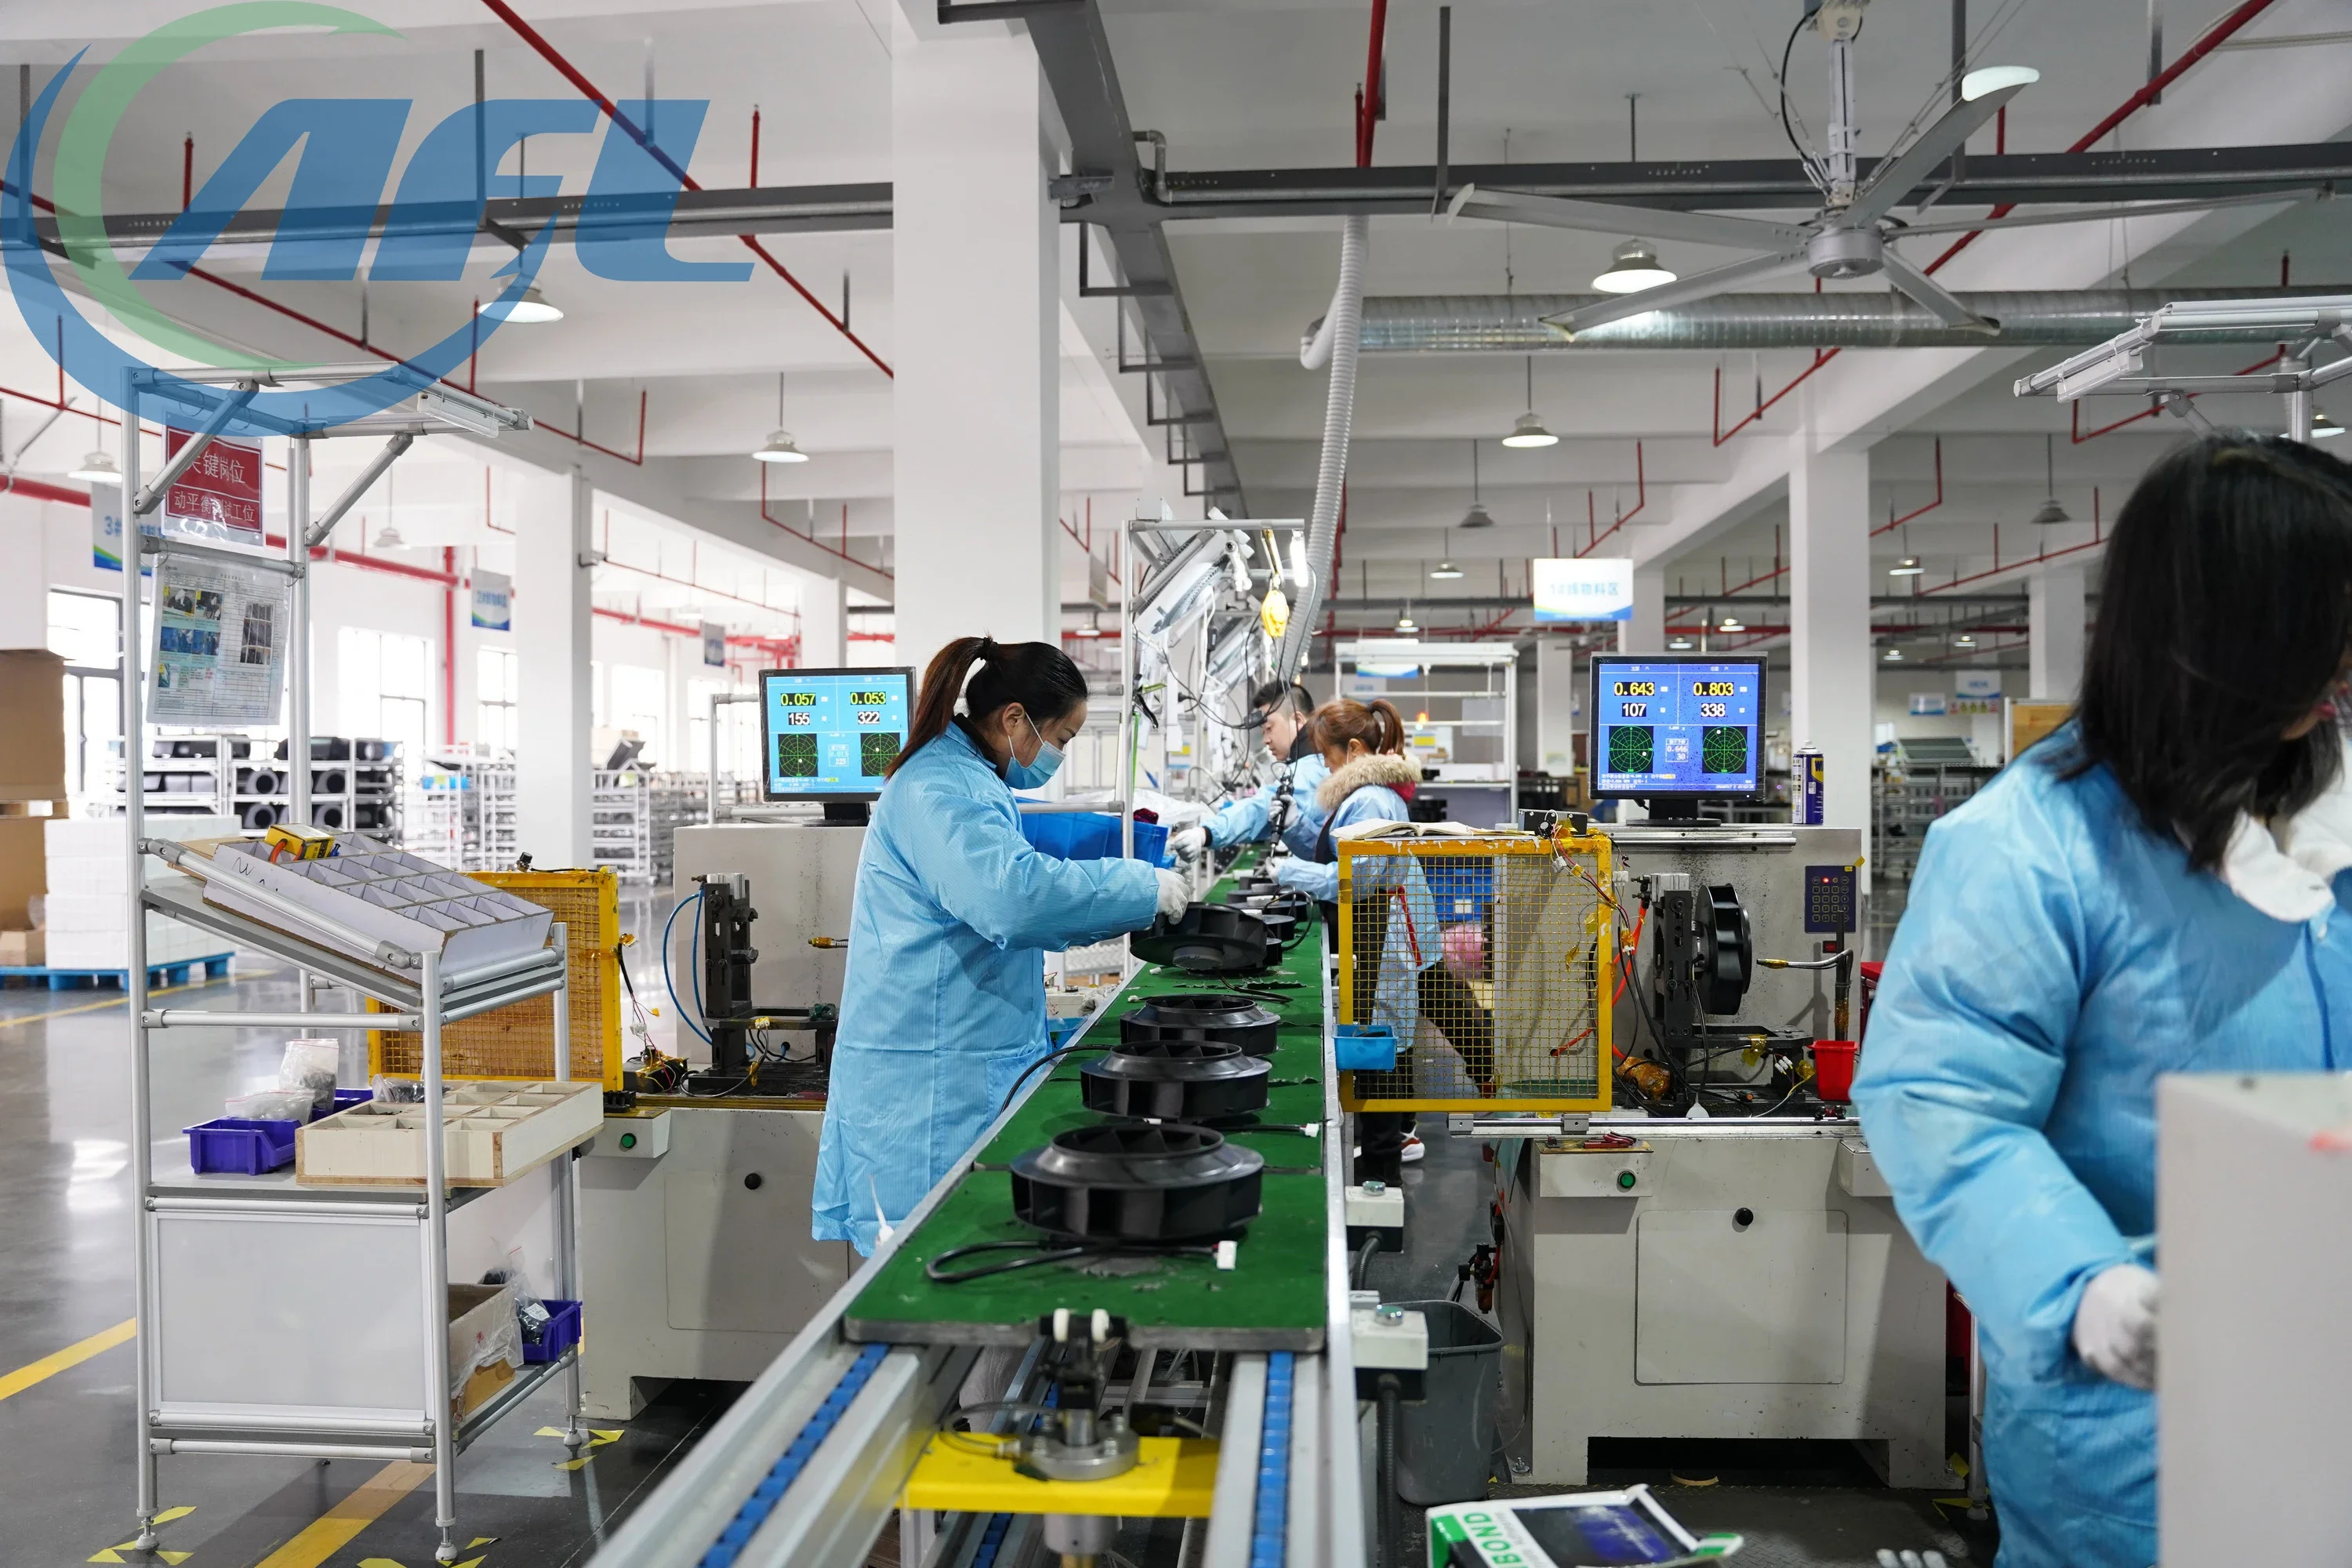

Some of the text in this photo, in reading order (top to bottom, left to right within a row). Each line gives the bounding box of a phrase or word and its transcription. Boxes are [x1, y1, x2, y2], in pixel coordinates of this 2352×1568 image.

[1614, 682, 1655, 696] 0.643
[1693, 682, 1733, 696] 0.803
[781, 693, 816, 706] 0.057
[850, 691, 887, 705] 0.053
[1622, 702, 1646, 717] 107
[1700, 702, 1726, 717] 338
[789, 712, 811, 725] 155
[858, 711, 880, 724] 322
[1464, 1512, 1530, 1568] BOND
